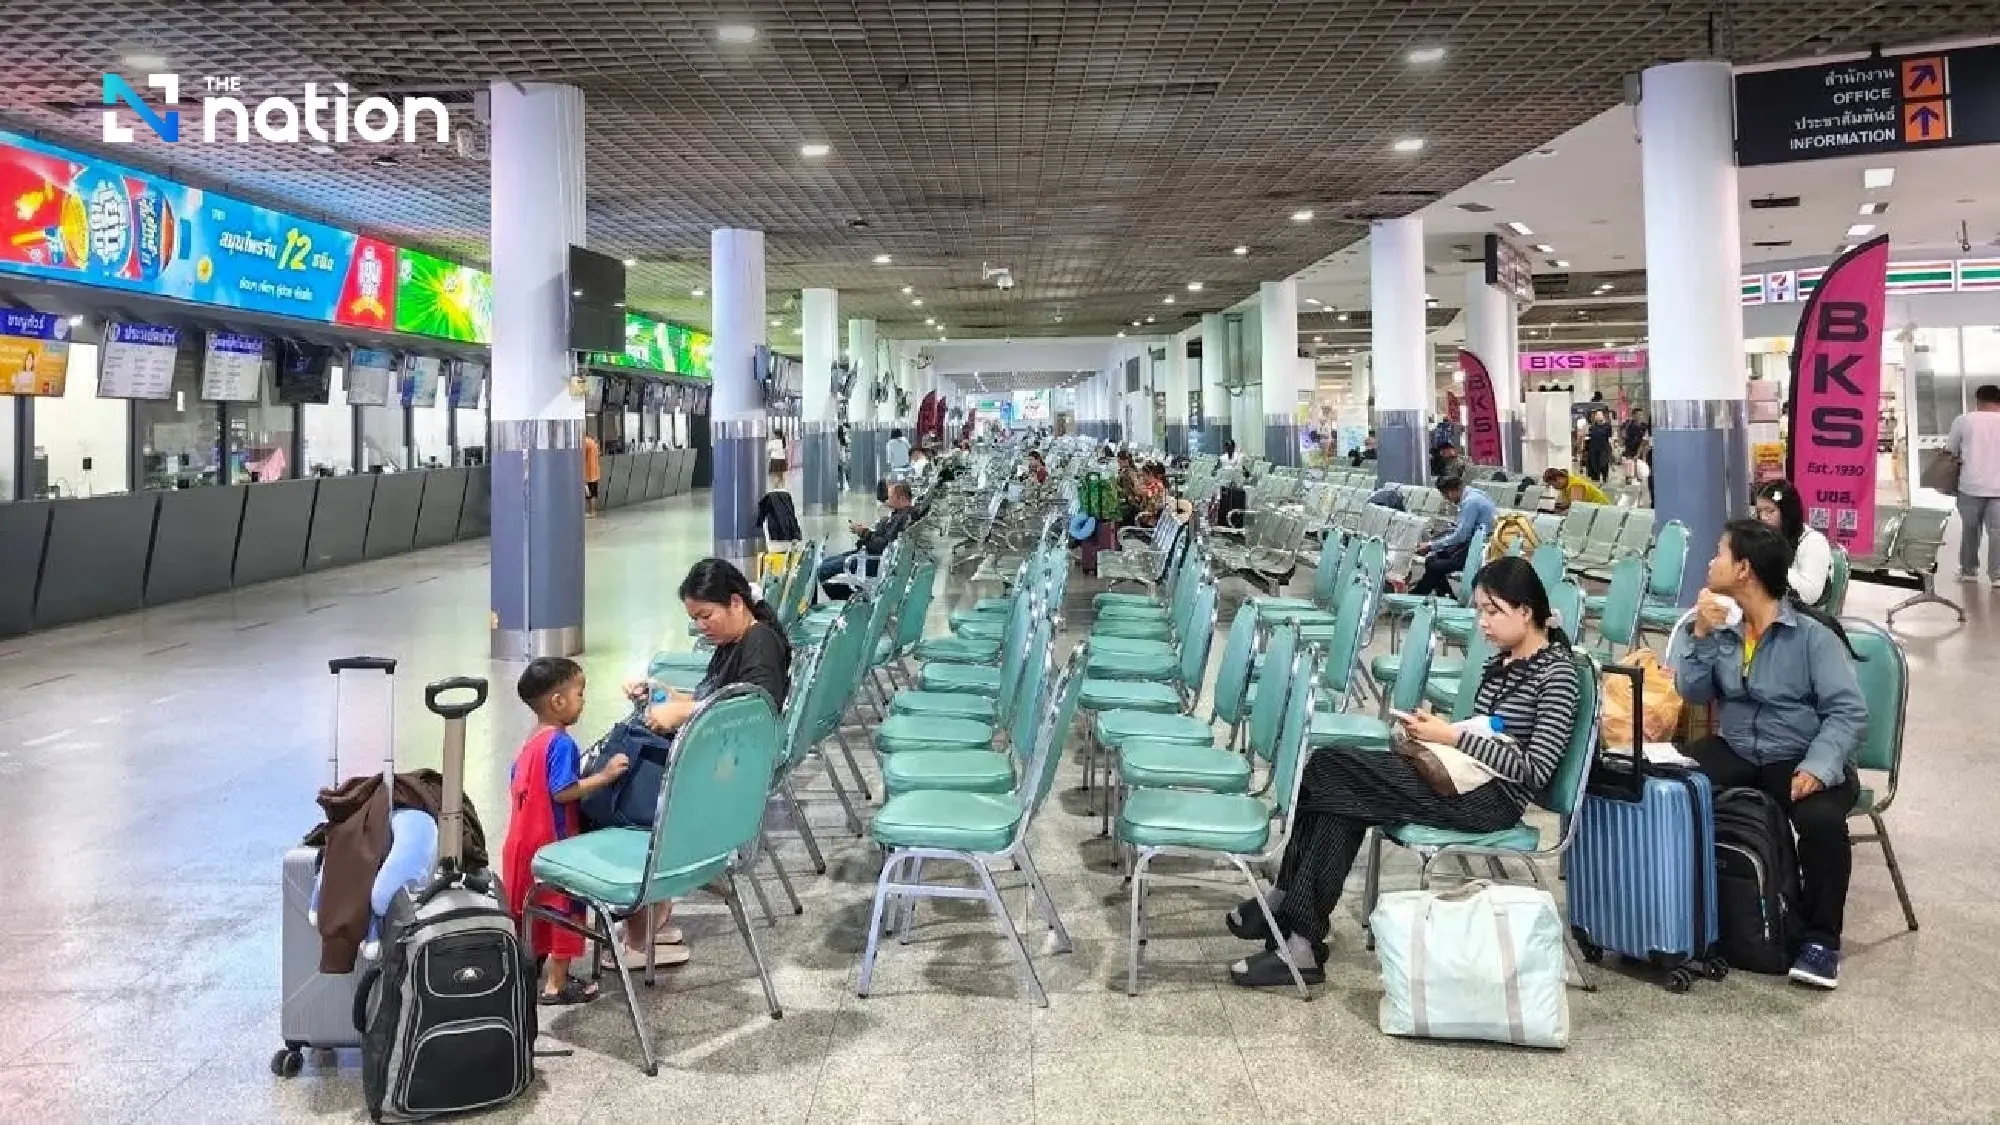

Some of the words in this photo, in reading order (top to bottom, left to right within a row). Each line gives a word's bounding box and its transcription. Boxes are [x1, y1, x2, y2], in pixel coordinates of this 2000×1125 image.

[1824, 67, 1895, 87] สำนักงาน
[1833, 87, 1892, 105] OFFICE
[1794, 105, 1896, 130] ประชาสัมพันธ์
[1790, 128, 1896, 150] INFORMATION
[277, 227, 312, 270] 12
[1530, 355, 1585, 369] BKS
[1811, 303, 1869, 447] BKS
[1469, 374, 1493, 433] BKS
